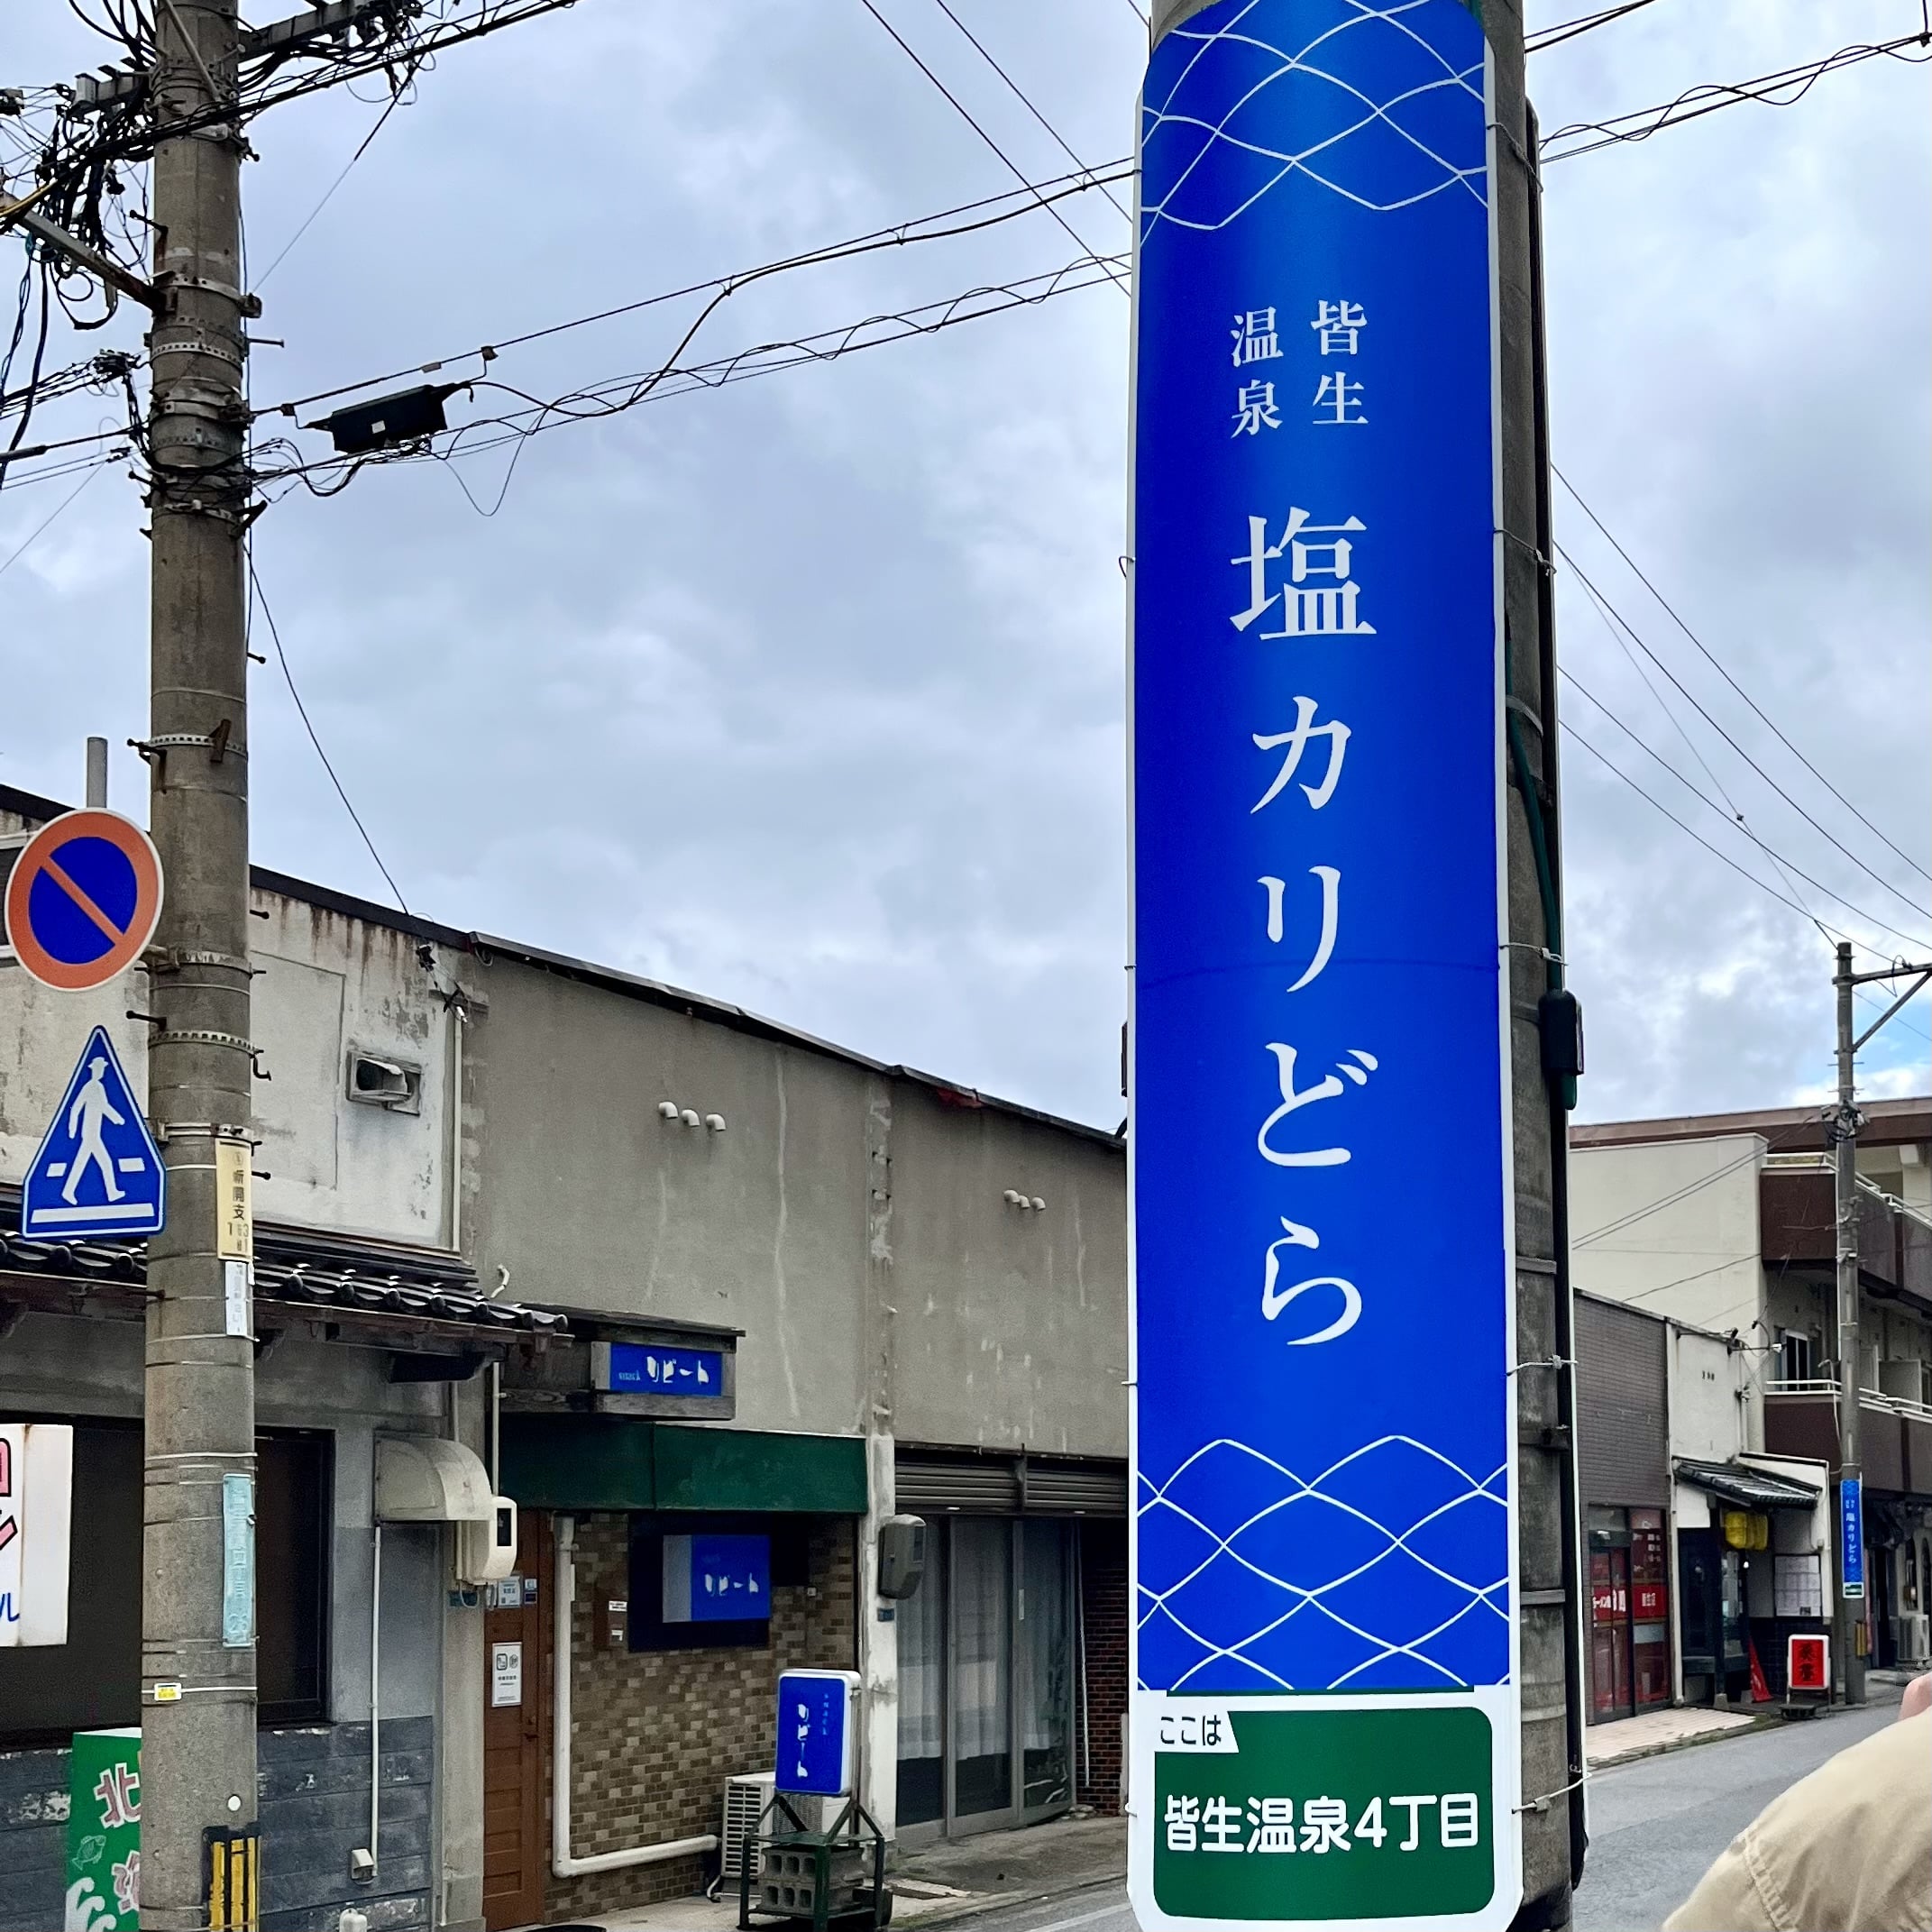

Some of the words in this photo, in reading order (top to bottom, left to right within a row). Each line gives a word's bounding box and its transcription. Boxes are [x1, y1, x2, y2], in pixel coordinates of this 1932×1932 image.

[1231, 307, 1284, 438] 温泉
[1310, 299, 1369, 427] 皆生
[1230, 507, 1378, 1346] 塩カリどら
[1160, 1714, 1222, 1746] ここは
[1164, 1791, 1479, 1854] 皆生温泉4丁目
